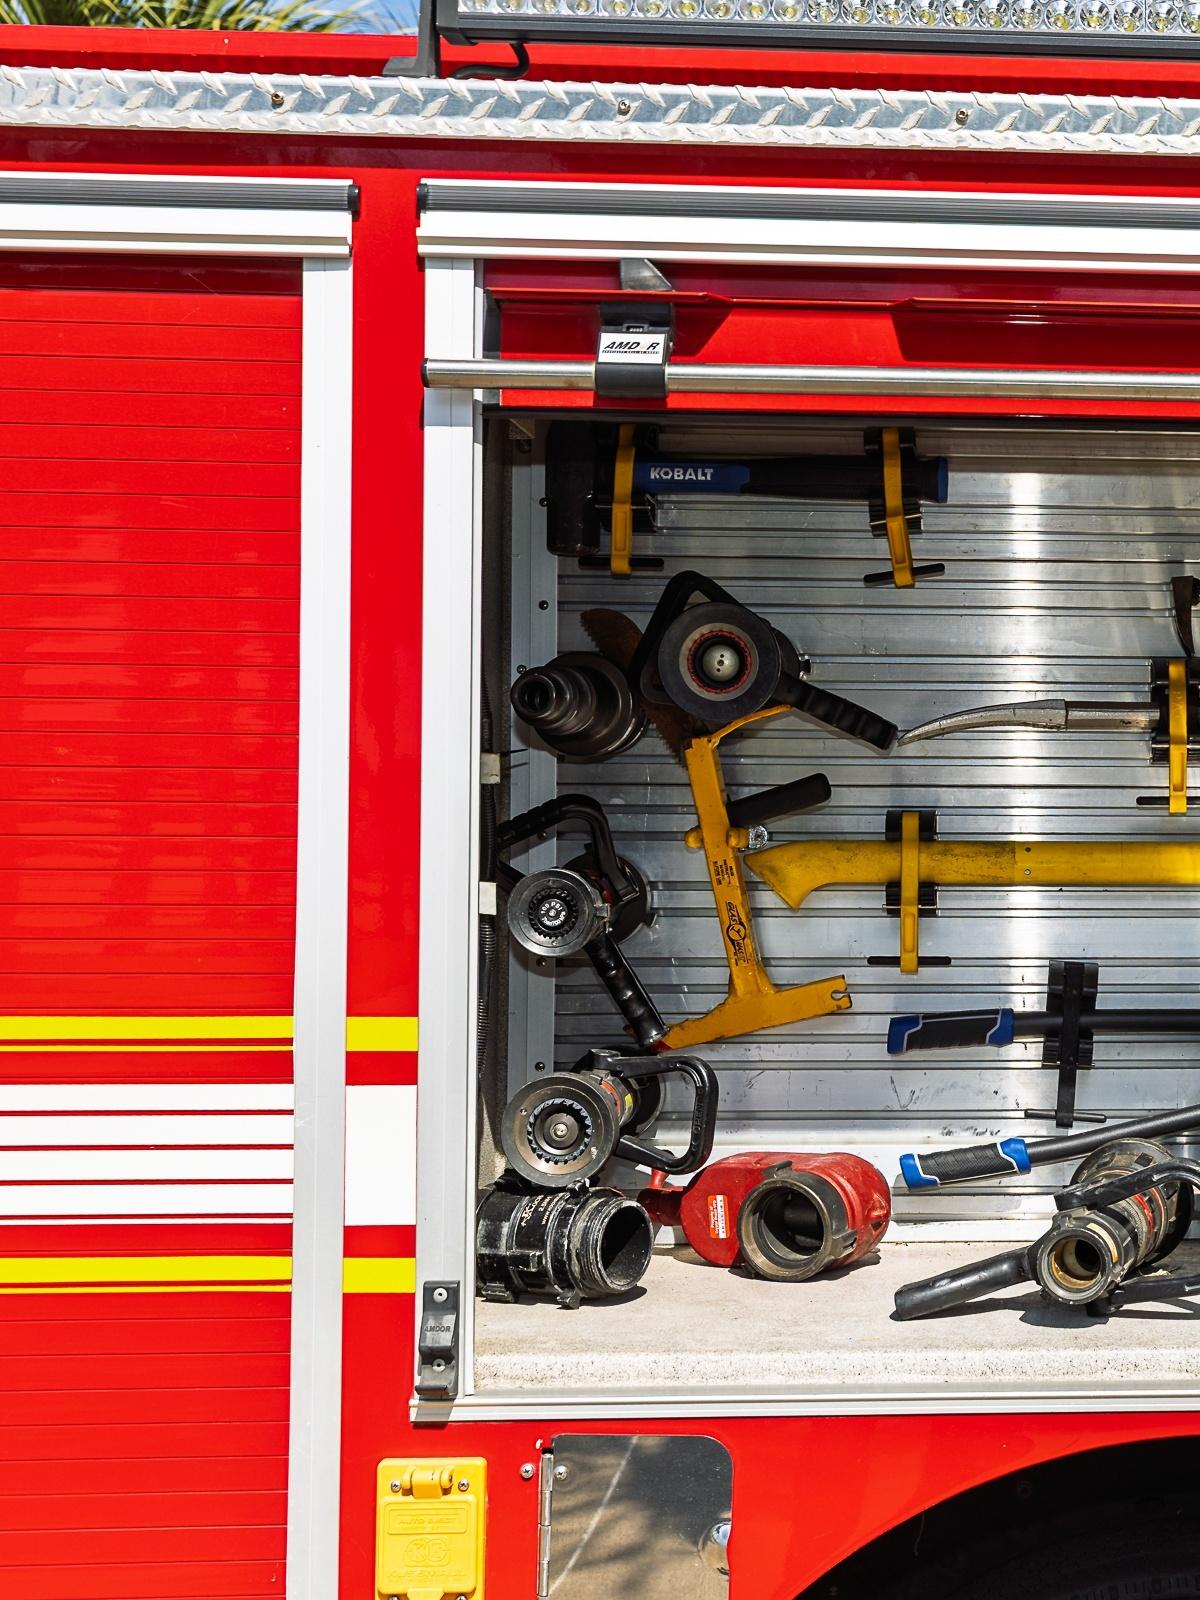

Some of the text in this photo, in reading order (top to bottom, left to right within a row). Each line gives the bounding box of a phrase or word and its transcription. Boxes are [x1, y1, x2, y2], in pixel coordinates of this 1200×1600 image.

[604, 342, 660, 350] AMDR
[650, 467, 714, 480] KOBALT
[540, 902, 562, 914] 100 PSI
